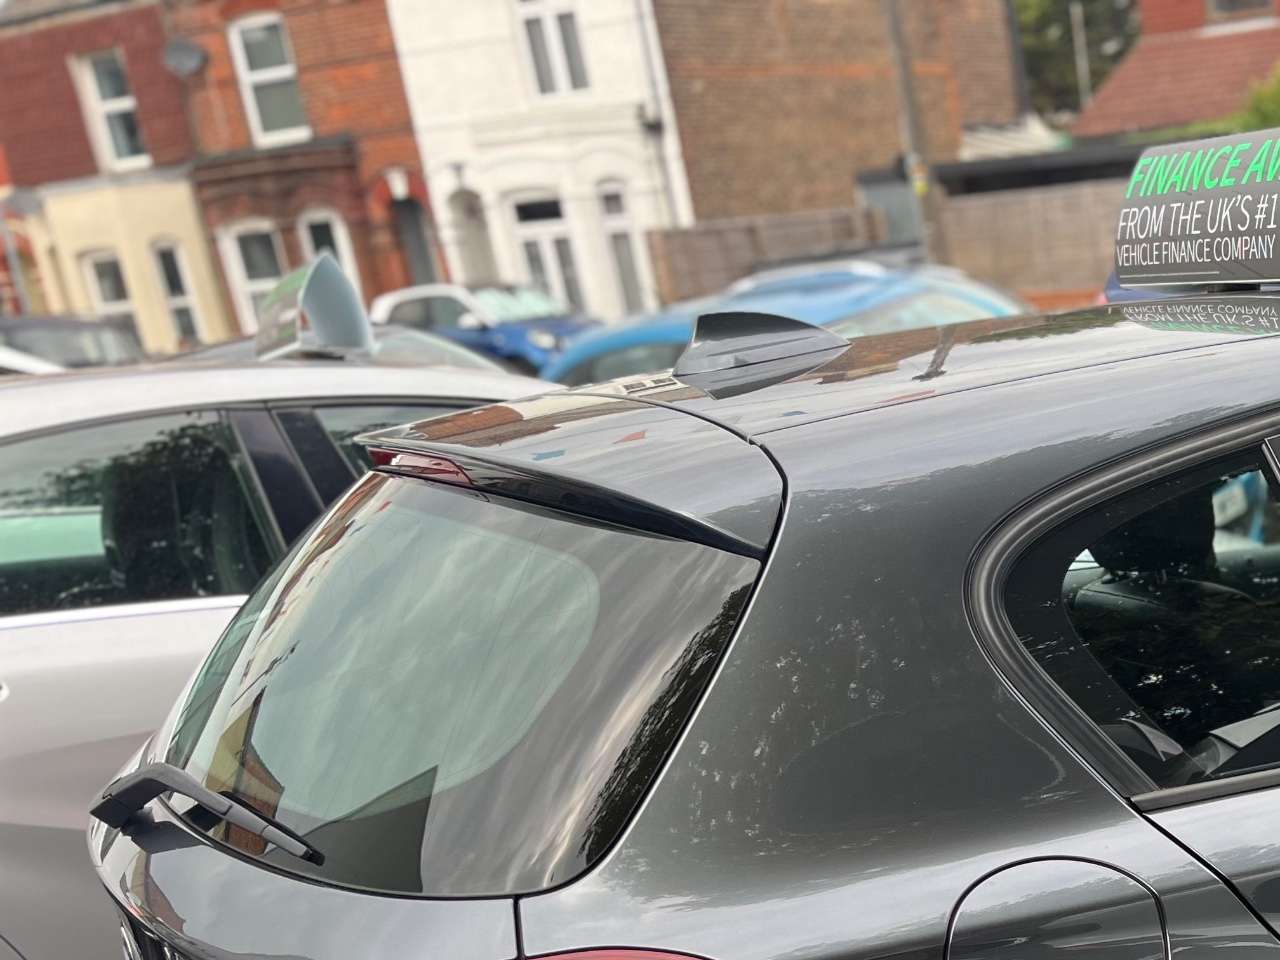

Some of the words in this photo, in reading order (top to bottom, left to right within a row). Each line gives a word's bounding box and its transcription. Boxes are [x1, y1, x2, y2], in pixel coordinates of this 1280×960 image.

[1126, 143, 1252, 199] FINANCE
[1117, 204, 1166, 240] FROM
[1169, 200, 1205, 237] THE
[1254, 193, 1279, 230] #1
[1116, 241, 1161, 267] VEHICLE
[1162, 238, 1211, 265] FINANCE
[1213, 233, 1276, 262] COMPANY
